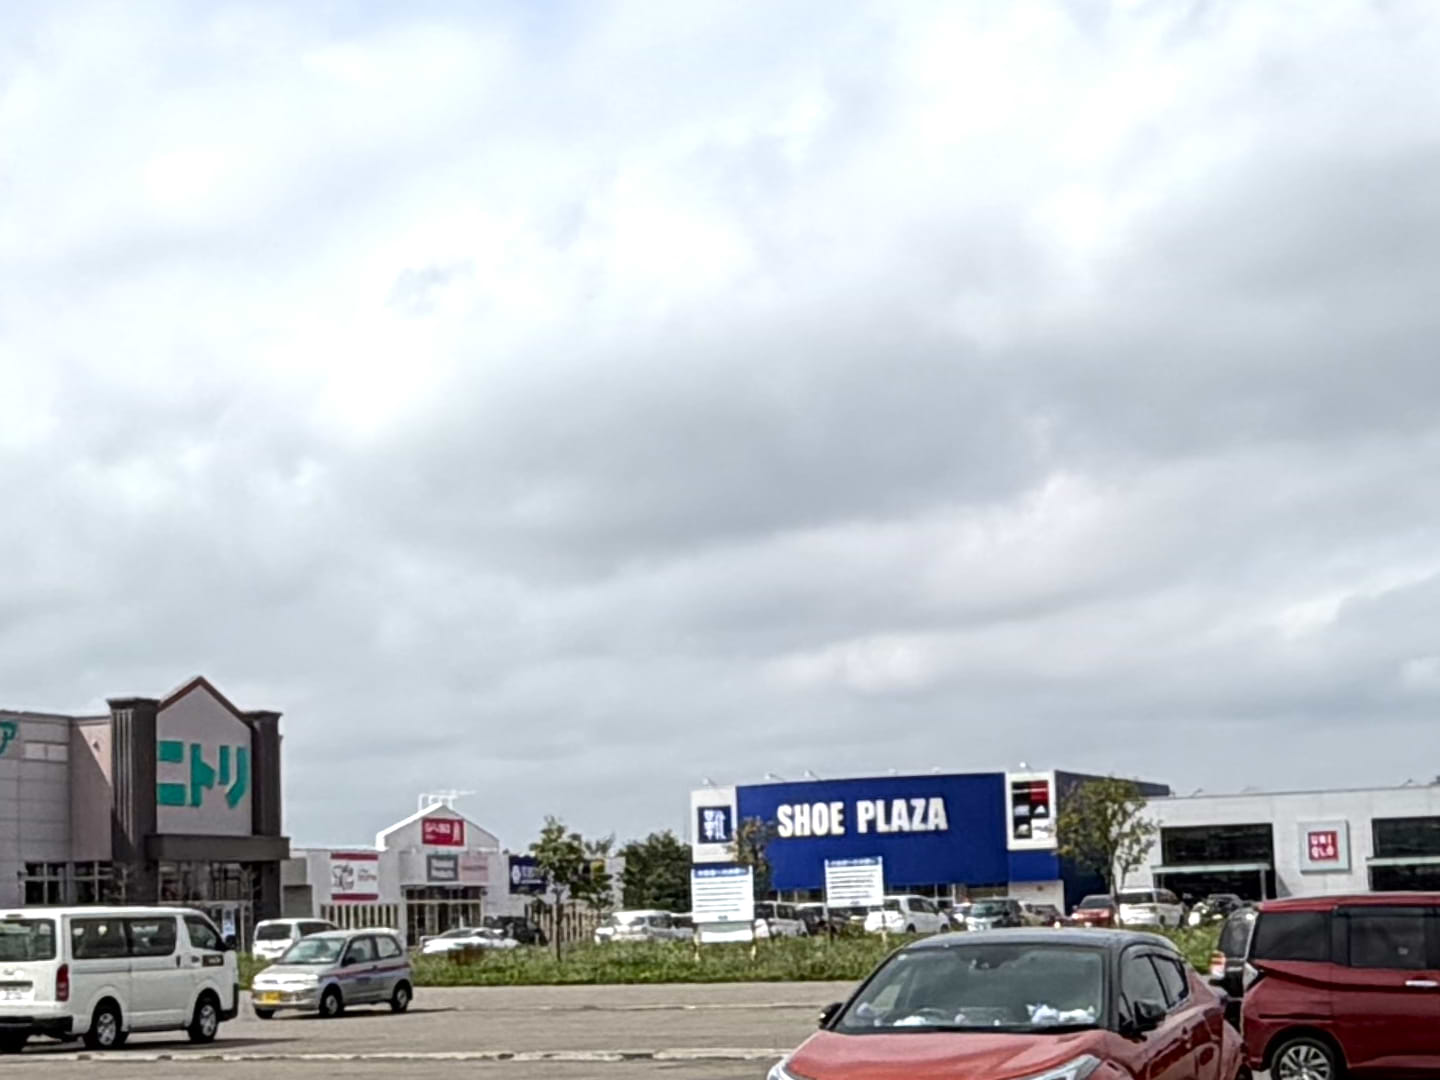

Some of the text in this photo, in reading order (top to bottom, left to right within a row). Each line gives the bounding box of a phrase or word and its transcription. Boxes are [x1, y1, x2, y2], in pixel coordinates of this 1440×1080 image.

[157, 740, 248, 810] ニトリ
[777, 797, 949, 838] SHOE PLAZA
